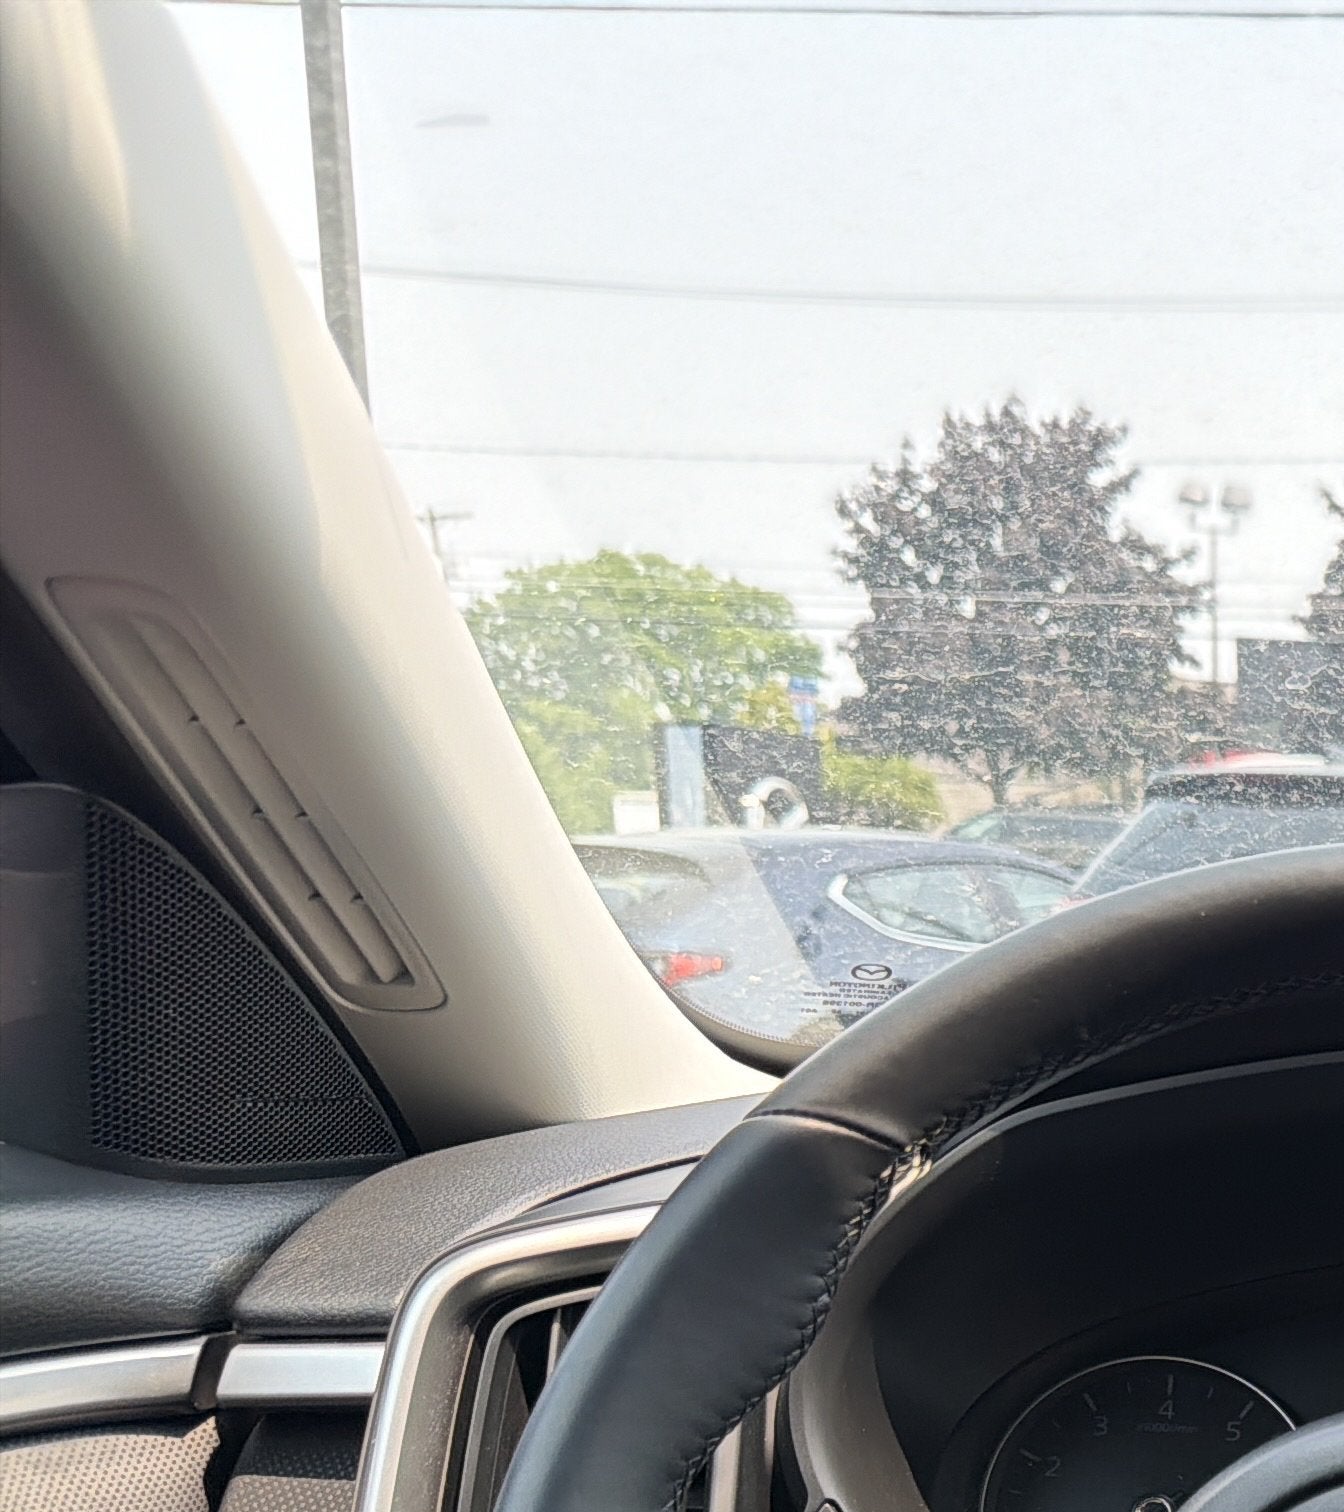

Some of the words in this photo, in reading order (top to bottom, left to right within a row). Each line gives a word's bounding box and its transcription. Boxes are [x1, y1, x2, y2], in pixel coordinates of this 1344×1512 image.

[1158, 1400, 1175, 1421] 4
[1092, 1415, 1108, 1436] 3
[1225, 1421, 1241, 1442] 5
[1044, 1456, 1061, 1478] 2
